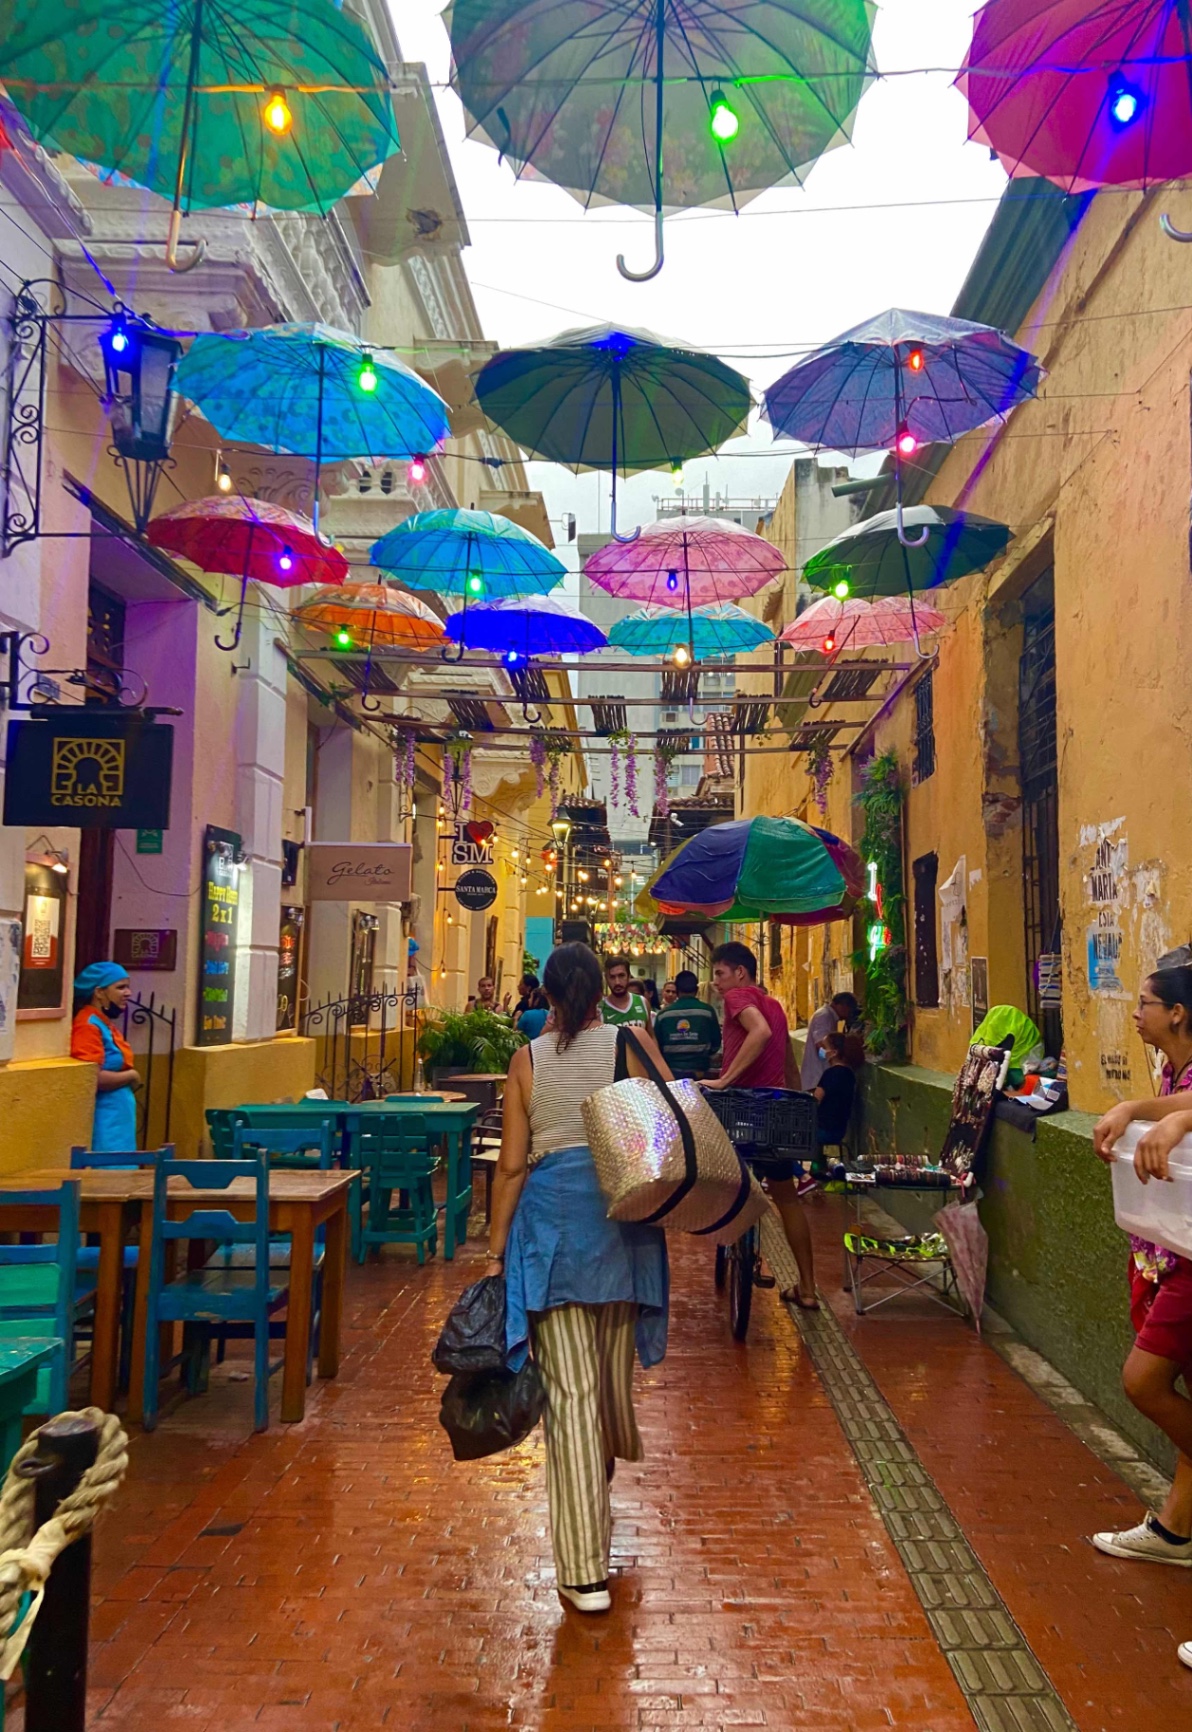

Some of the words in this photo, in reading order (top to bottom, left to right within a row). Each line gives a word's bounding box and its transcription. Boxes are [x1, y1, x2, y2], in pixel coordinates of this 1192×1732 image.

[77, 783, 98, 794] LA
[51, 794, 122, 807] CASONA
[455, 823, 467, 844] I
[454, 843, 493, 864] SM
[326, 861, 395, 886] Gelato
